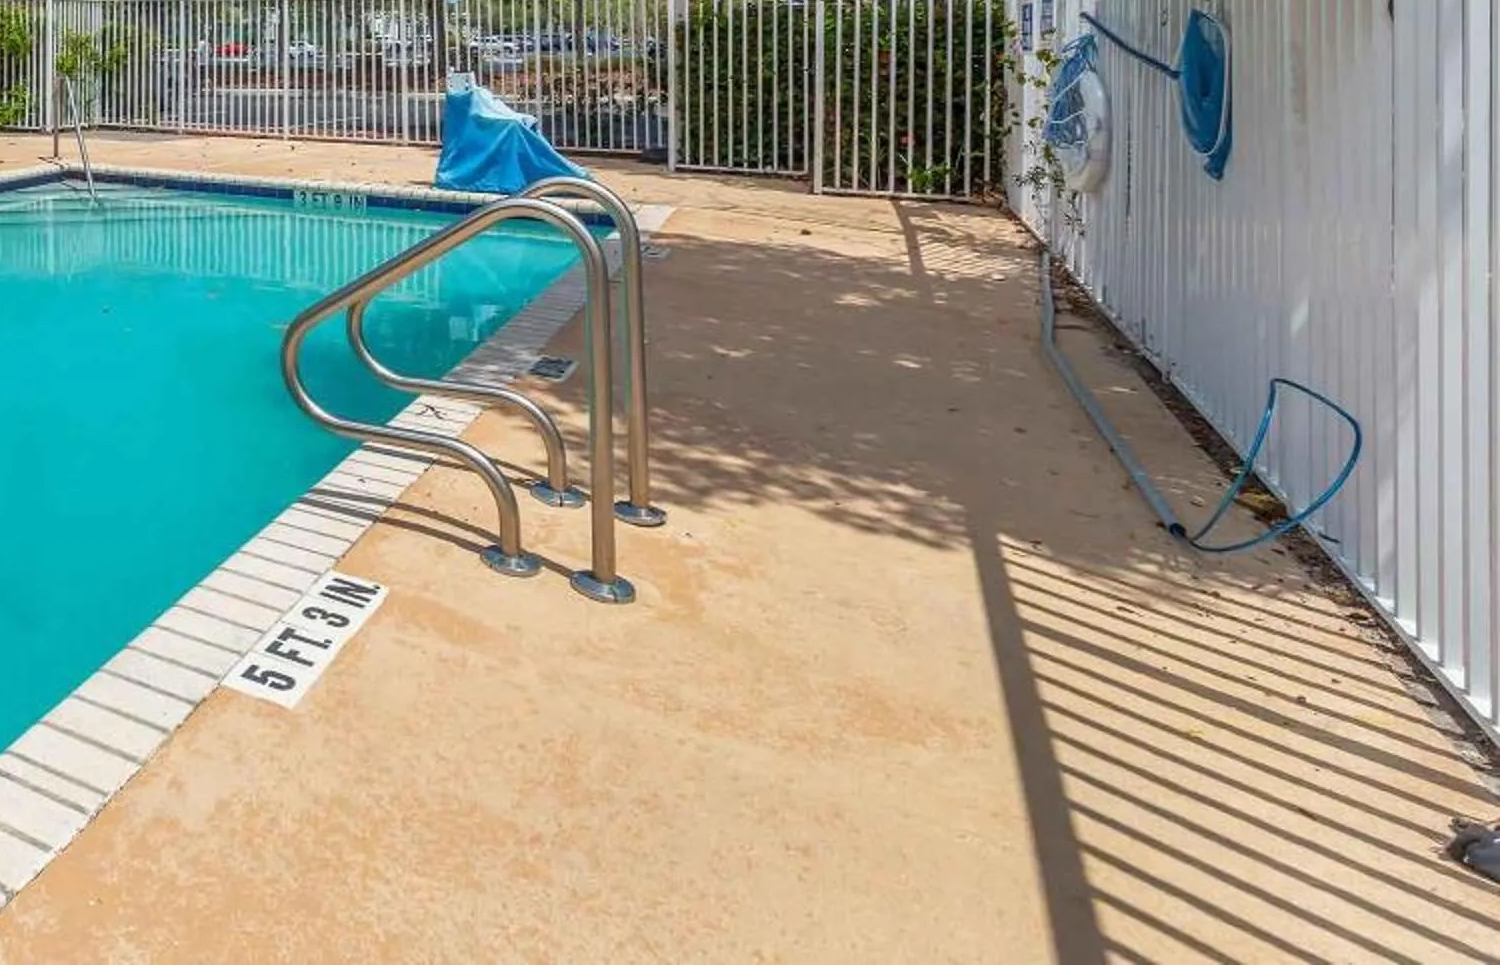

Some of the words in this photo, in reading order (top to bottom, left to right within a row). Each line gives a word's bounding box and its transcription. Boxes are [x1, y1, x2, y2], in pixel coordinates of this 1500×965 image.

[319, 578, 381, 609] IN.
[302, 606, 350, 628] 3
[264, 627, 333, 667] FT.
[241, 664, 297, 691] 5
